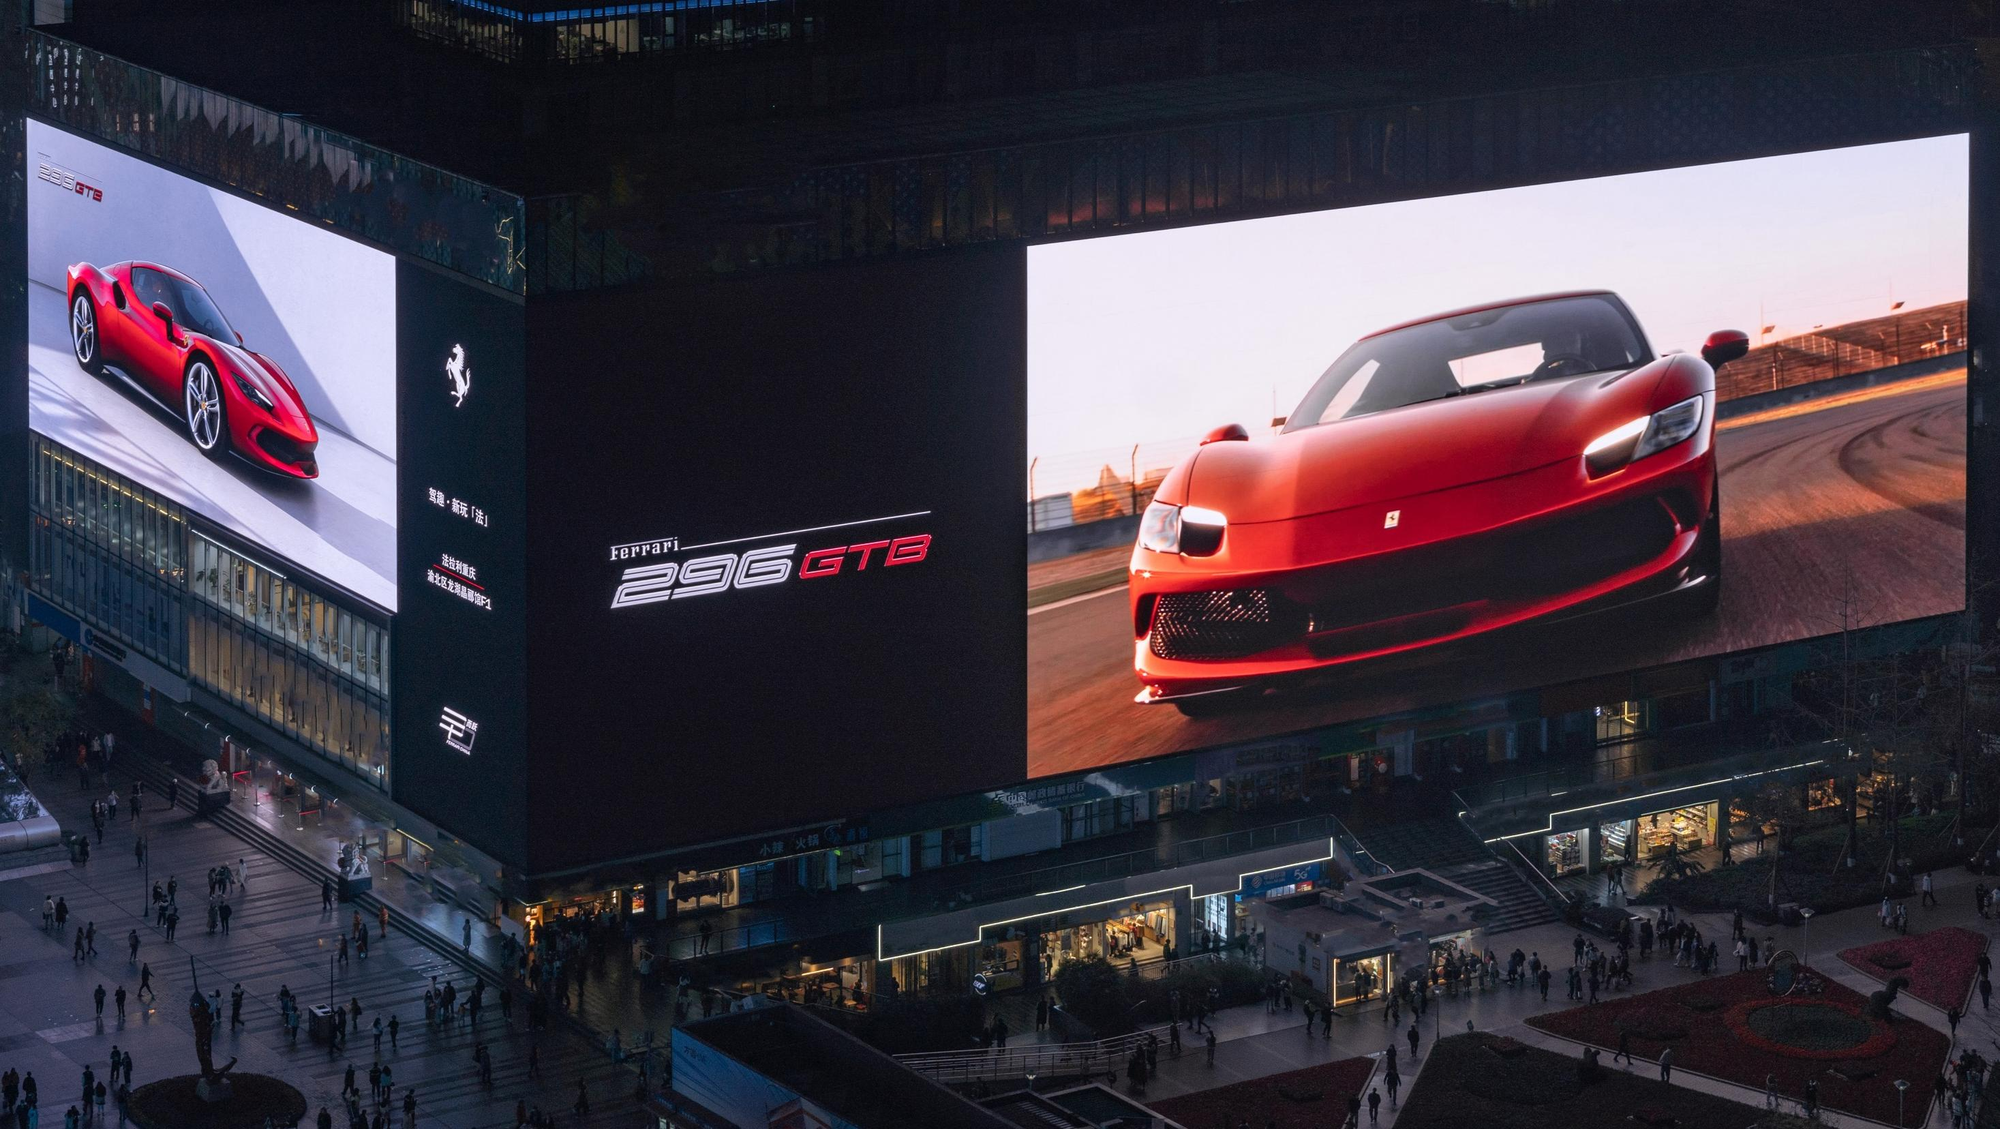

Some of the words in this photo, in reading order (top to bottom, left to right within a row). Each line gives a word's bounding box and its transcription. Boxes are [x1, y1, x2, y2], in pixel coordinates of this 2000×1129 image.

[75, 181, 104, 203] GTB
[610, 537, 679, 561] Ferrari
[441, 553, 477, 581] 法拉利重庆
[610, 543, 797, 609] 296
[799, 534, 932, 579] GTB
